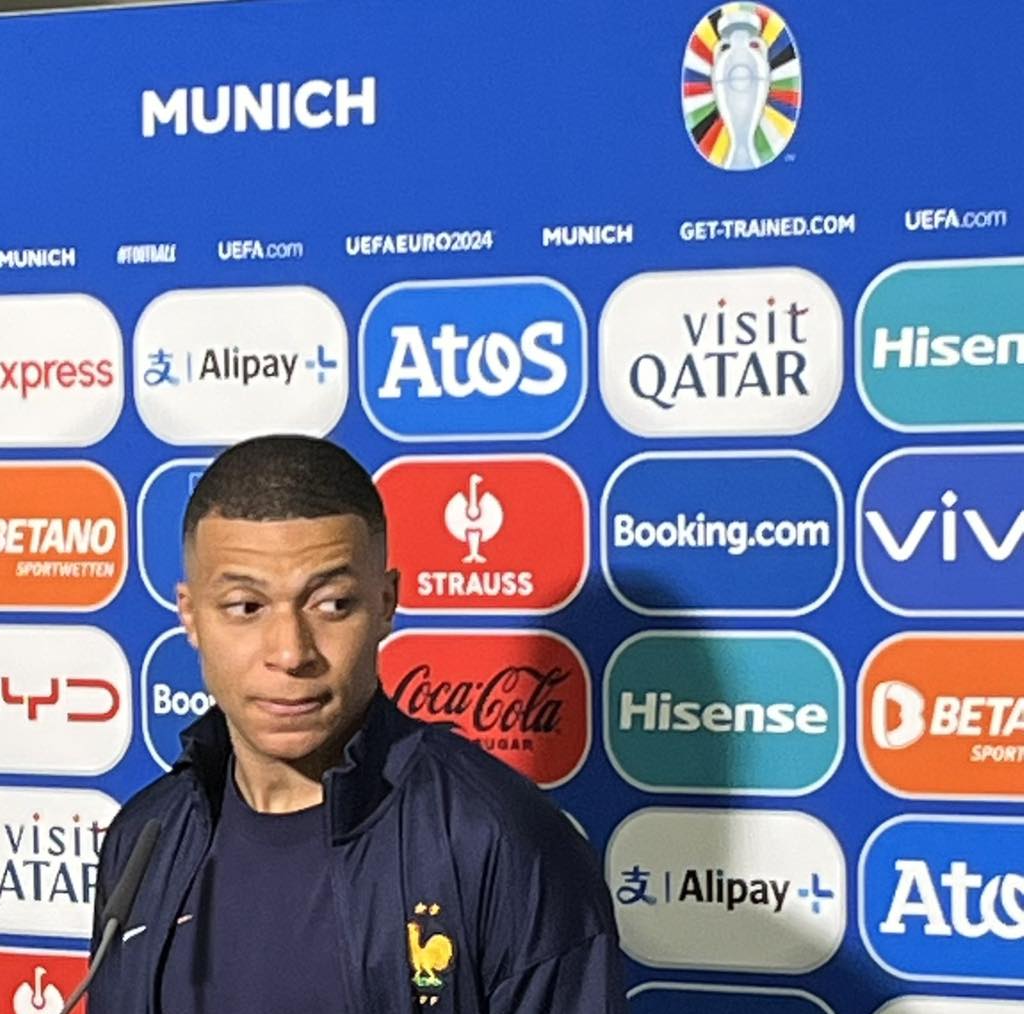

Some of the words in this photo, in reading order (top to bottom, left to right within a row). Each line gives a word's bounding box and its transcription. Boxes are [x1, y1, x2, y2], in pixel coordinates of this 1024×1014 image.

[141, 75, 378, 138] MUNICH
[679, 213, 856, 241] GET-TRAINED.COM
[905, 207, 1007, 231] UEFA.com
[345, 230, 494, 256] UEFAEURO2024
[542, 224, 633, 247] MUNICH
[217, 239, 303, 261] UEFA.com
[683, 297, 810, 346] visit
[378, 320, 568, 399] Atos
[629, 350, 810, 408] QATAR
[613, 514, 830, 554] Booking.com
[15, 561, 114, 577] SPORTWETTEN
[417, 571, 534, 597] STRAUSS
[618, 692, 828, 734] Hisense
